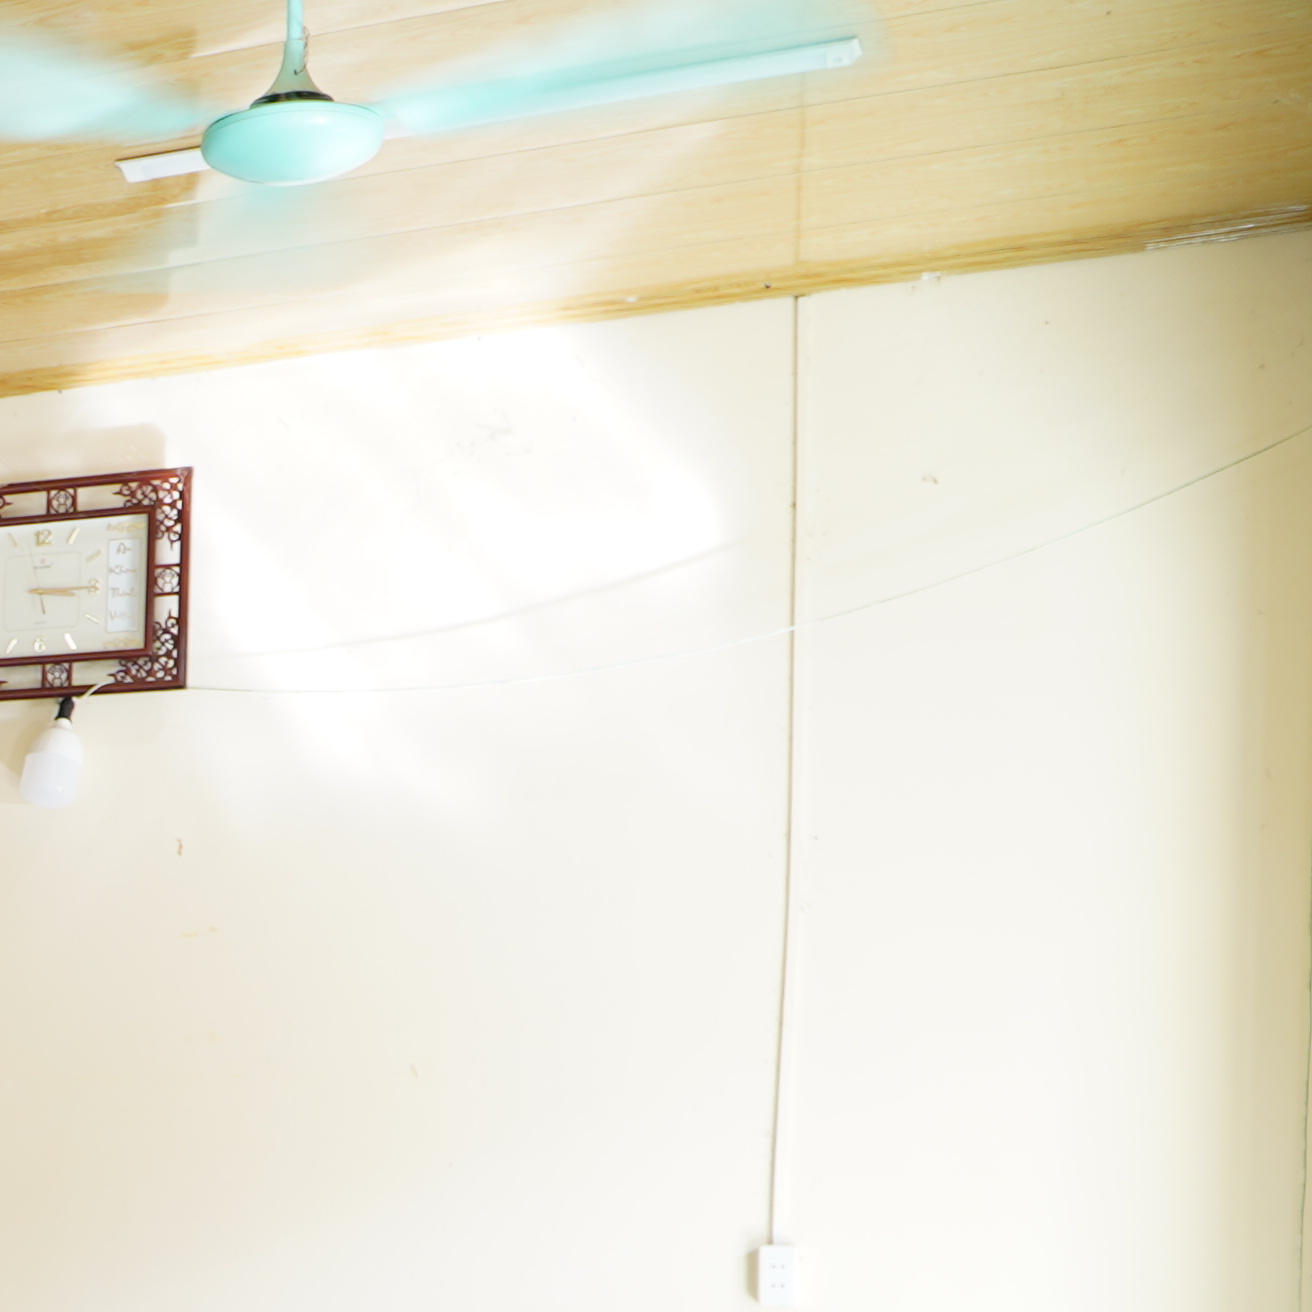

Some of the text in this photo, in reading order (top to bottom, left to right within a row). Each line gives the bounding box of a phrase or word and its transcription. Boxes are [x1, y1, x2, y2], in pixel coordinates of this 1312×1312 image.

[34, 529, 52, 547] 12
[87, 578, 101, 596] 3
[33, 635, 47, 653] 6
